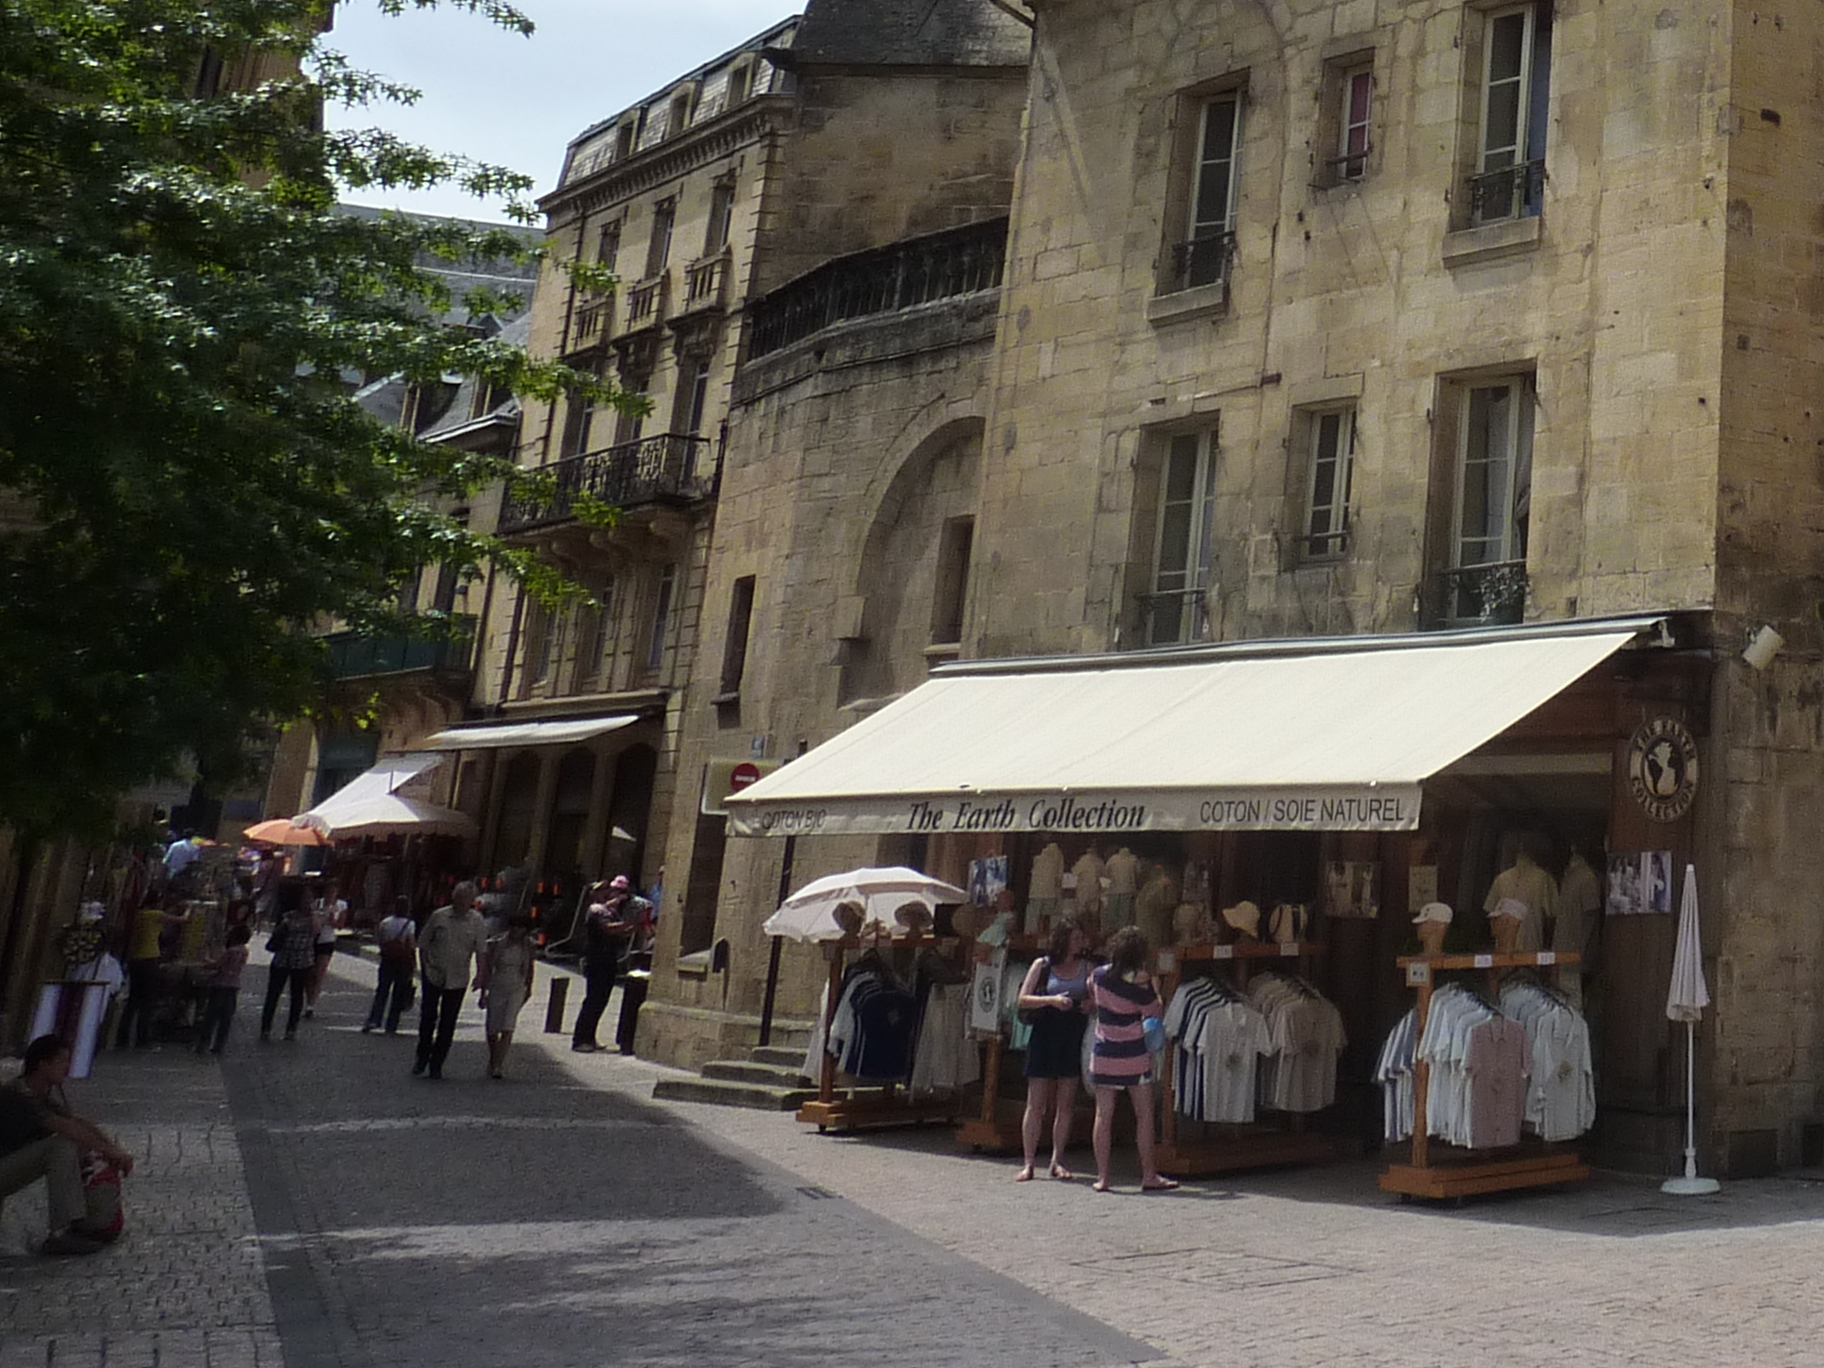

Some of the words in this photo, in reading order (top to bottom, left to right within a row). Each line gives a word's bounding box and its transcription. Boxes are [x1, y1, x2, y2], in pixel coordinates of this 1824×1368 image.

[907, 801, 943, 830] The
[953, 799, 1016, 830] Earth
[1029, 798, 1146, 829] Collection
[1200, 800, 1260, 824] COTON
[1273, 799, 1316, 822] SOIE
[1320, 798, 1405, 822] NATUREL
